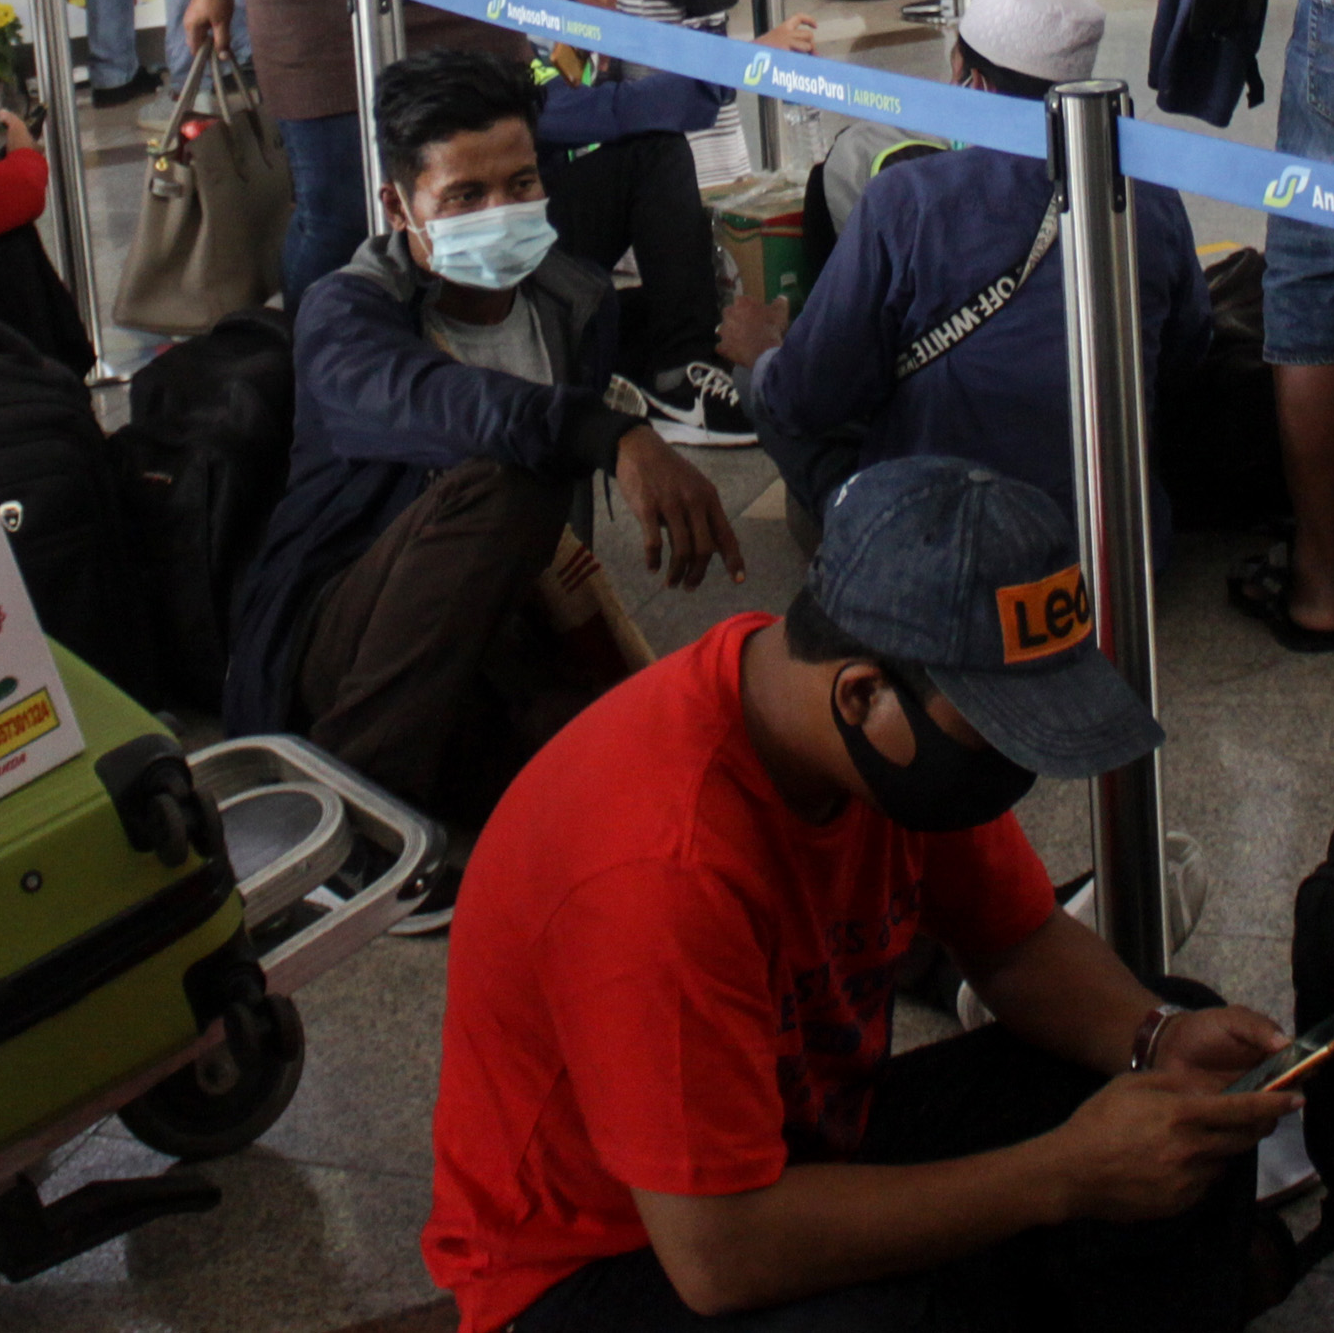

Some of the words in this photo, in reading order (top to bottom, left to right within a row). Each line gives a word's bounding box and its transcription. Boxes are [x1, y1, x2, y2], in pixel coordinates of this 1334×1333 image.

[565, 18, 601, 41] AIRPORTS
[853, 90, 901, 115] AIRPORTS
[912, 276, 1016, 365] OFF-WHITE
